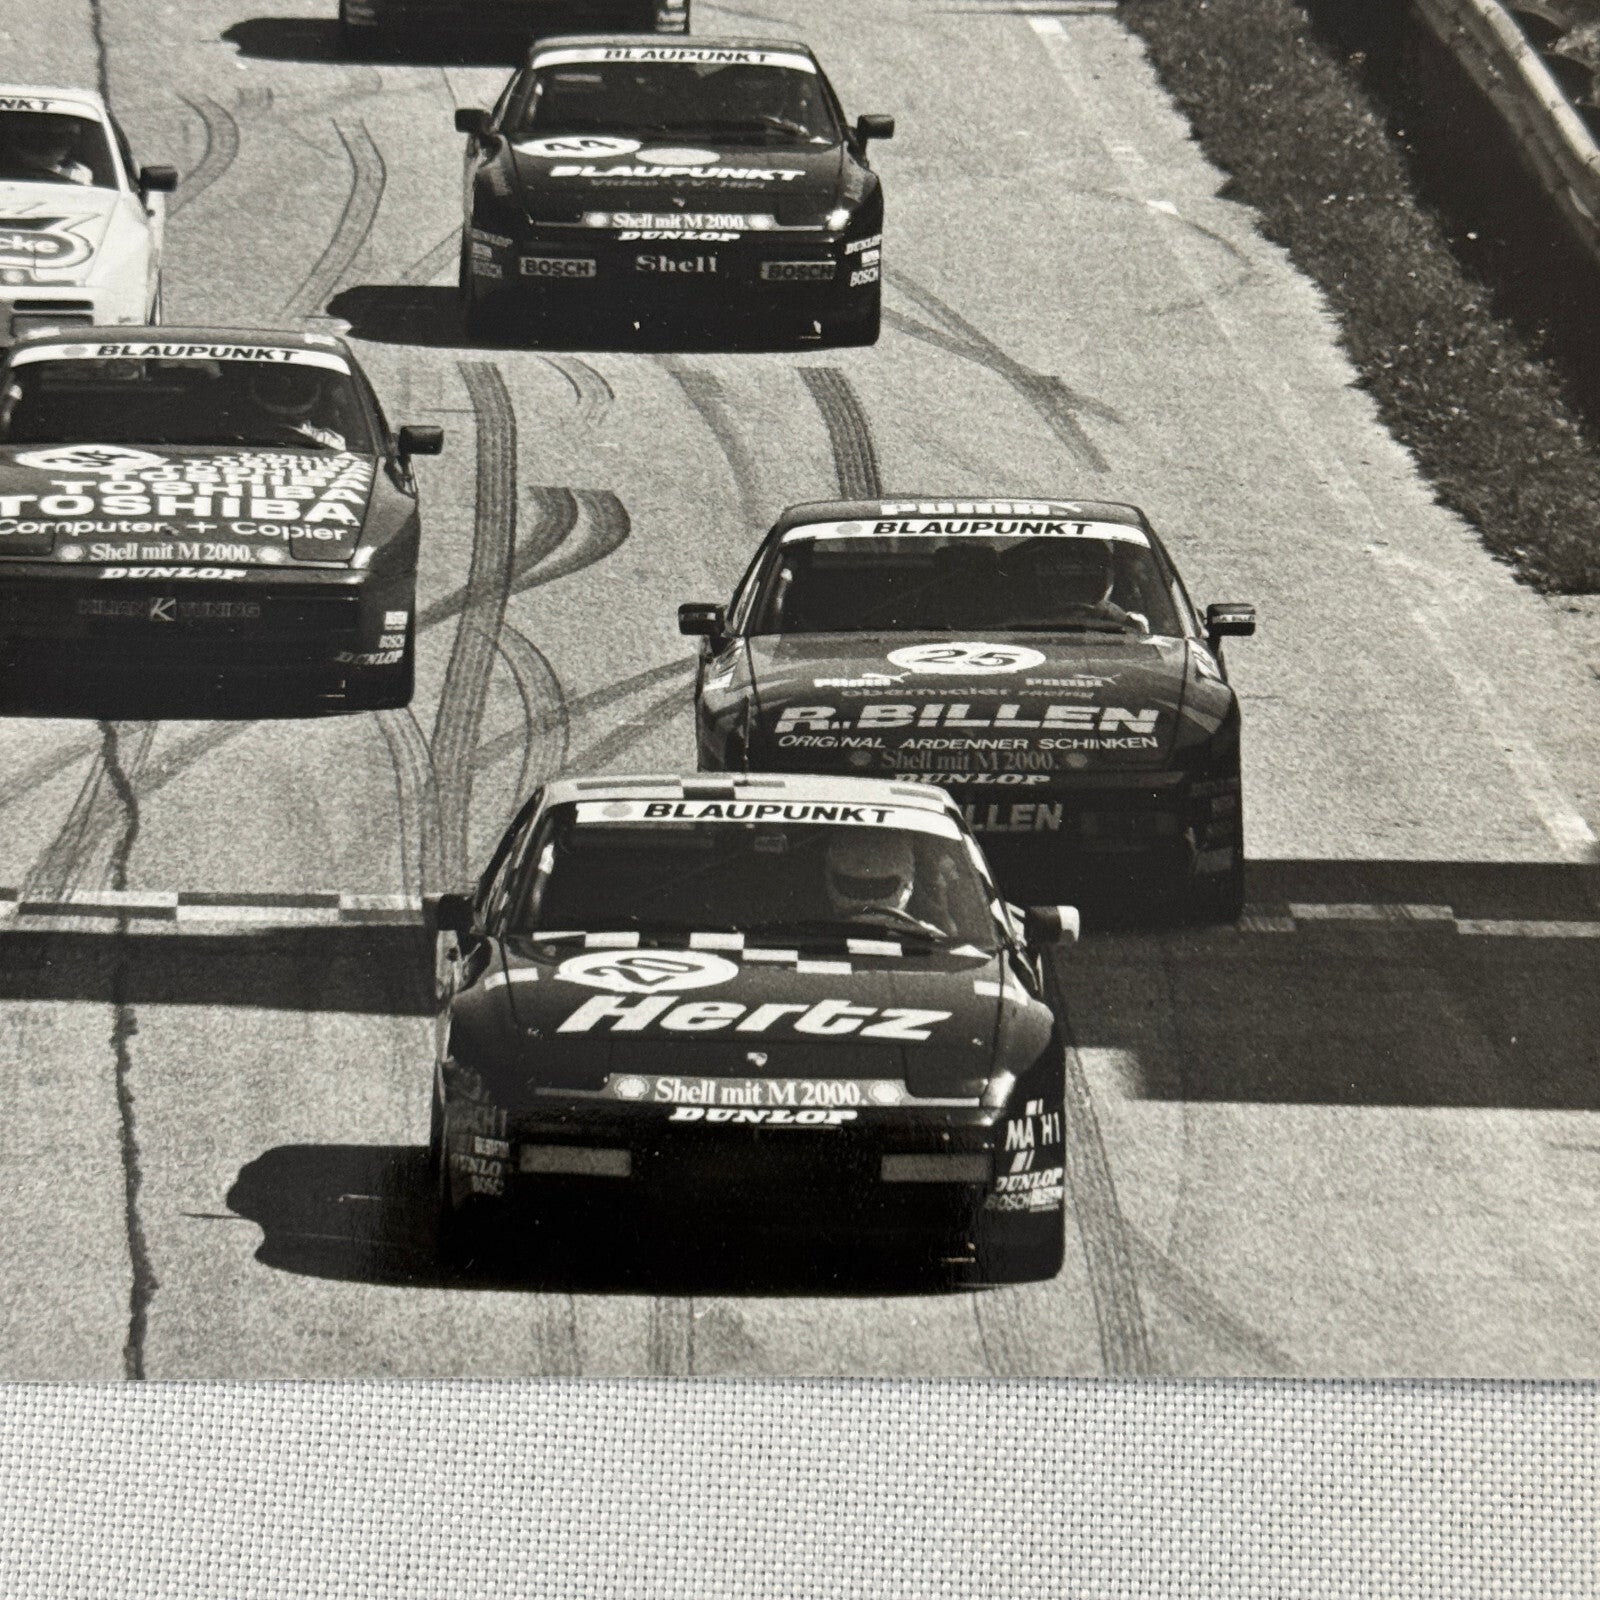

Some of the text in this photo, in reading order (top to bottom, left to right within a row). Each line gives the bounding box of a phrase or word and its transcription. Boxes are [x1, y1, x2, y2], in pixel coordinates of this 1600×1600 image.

[604, 49, 771, 63] BLAUPUNKT
[550, 165, 806, 181] BLAUPUNKT
[612, 213, 652, 229] Shell
[655, 215, 680, 229] mit
[682, 214, 703, 229] M
[618, 230, 742, 242] DUNLOP
[525, 260, 591, 277] BOSCH
[636, 254, 718, 273] Shell
[767, 263, 835, 279] BOSCH
[97, 344, 300, 361] BLAUPUNKT
[99, 470, 368, 492] TOSHIBA
[51, 480, 365, 506] TOSHIBA
[0, 495, 360, 527] TOSHIBA
[0, 518, 170, 538] Computer
[231, 521, 348, 542] Copier
[873, 521, 1092, 536] BLAUPUNKT
[89, 543, 138, 561] Shell
[142, 545, 173, 561] mit
[178, 545, 200, 561] M
[99, 567, 248, 581] DUNLOP
[335, 649, 404, 666] DUNLOP
[913, 648, 1022, 667] 25
[775, 703, 1158, 734] R.BILLEN
[778, 735, 1159, 751] ORIGINAL ARDENNER SCHINKEN
[881, 748, 932, 770] Shell
[938, 749, 971, 771] mit
[976, 750, 998, 771] M
[894, 771, 1051, 786] DUNLOP
[643, 803, 895, 824] BLAUPUNKT
[957, 802, 1064, 832] LLEN
[583, 957, 704, 987] 20
[557, 994, 953, 1042] Hertz
[653, 1078, 717, 1104] Shell
[720, 1080, 763, 1105] mit
[767, 1081, 799, 1106] M
[668, 1106, 858, 1124] DUNLOP
[995, 1167, 1064, 1192] DUNLOP
